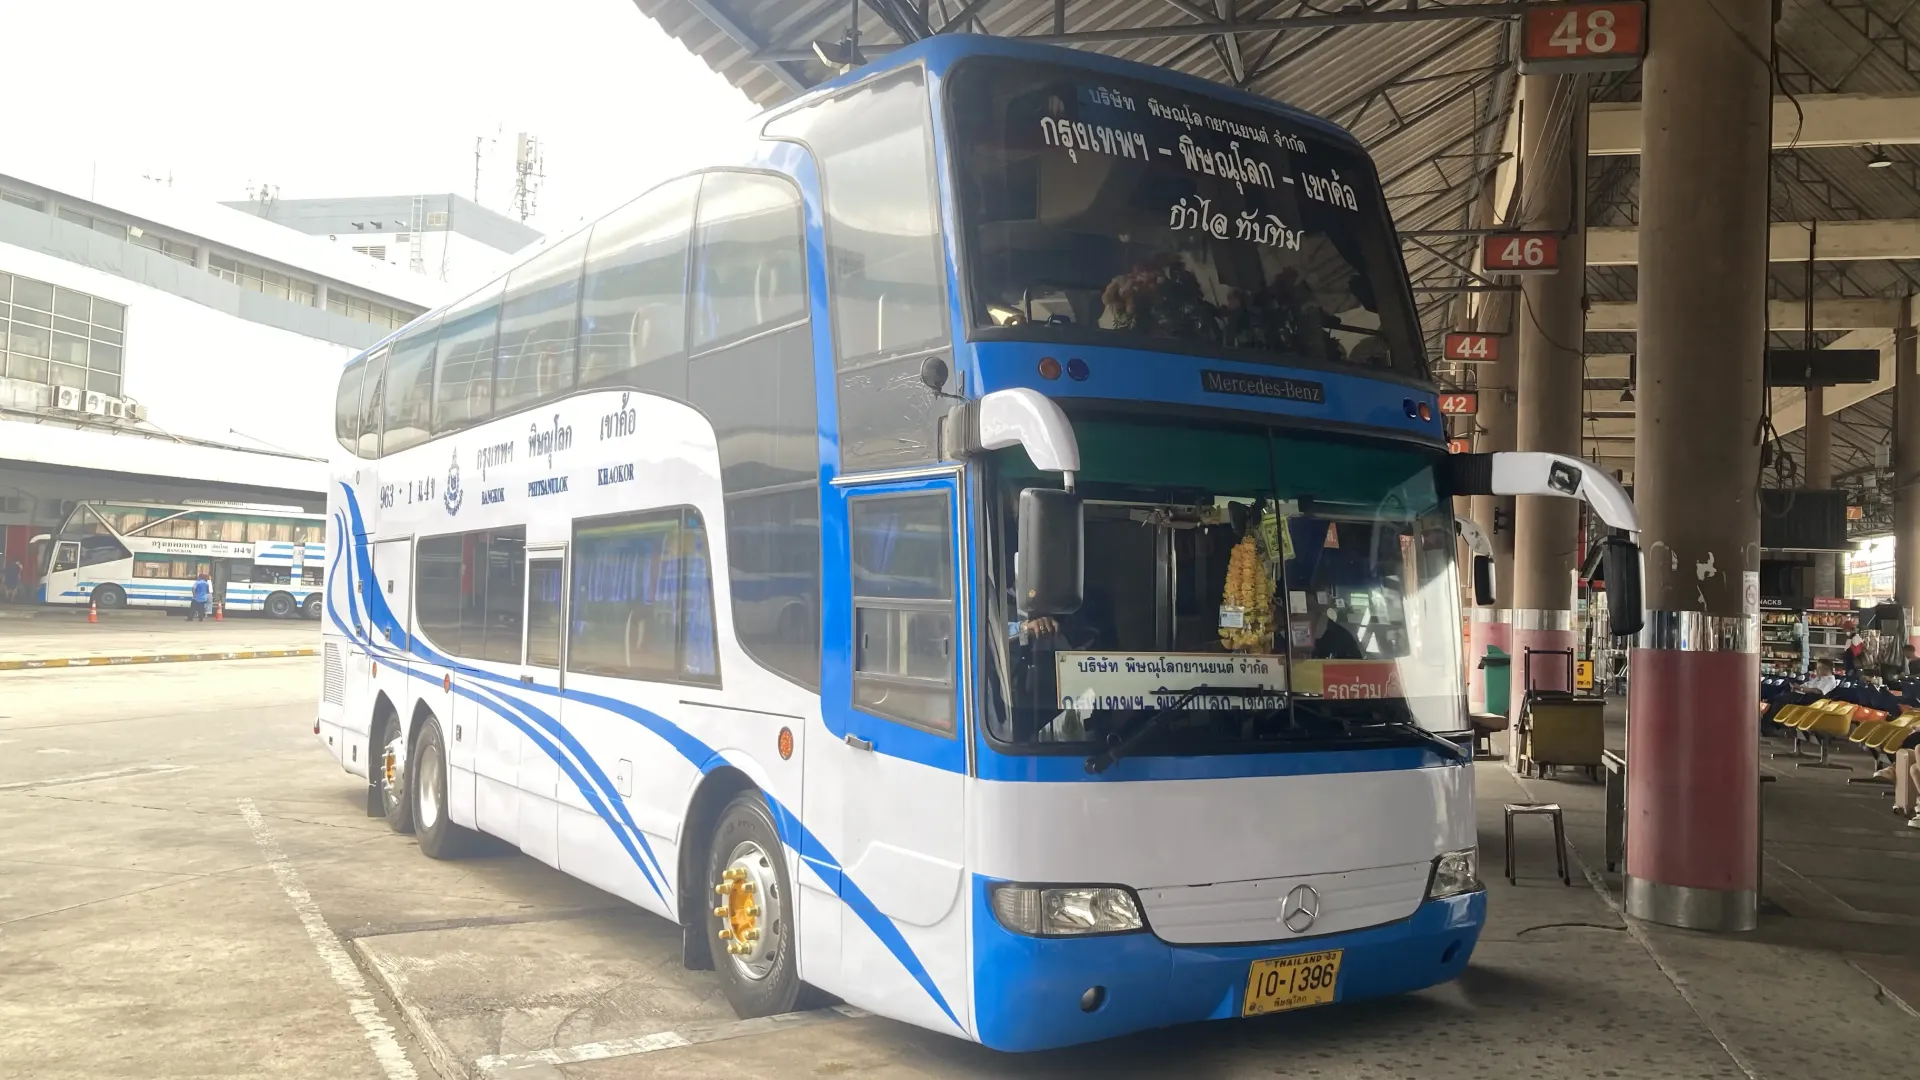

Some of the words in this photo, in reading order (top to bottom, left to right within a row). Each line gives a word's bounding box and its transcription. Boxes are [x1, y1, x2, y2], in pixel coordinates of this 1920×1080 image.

[1548, 9, 1617, 54] 48
[1088, 86, 1136, 112] บริษัท
[1273, 129, 1308, 154] จำกัด
[1040, 115, 1149, 164] กรุงเทพฯ
[1178, 134, 1275, 195] พิษณุโลก
[1301, 168, 1359, 212] เขาค้อ
[1169, 194, 1229, 240] กำไล
[1235, 208, 1305, 252] ทับทิม
[1501, 238, 1544, 266] 46
[1456, 337, 1488, 358] 44
[1208, 372, 1321, 401] Mercedes-Benz
[1442, 396, 1467, 413] 42
[528, 413, 572, 470] พิษณุโลก
[599, 391, 636, 441] เขาค้อ
[380, 483, 394, 509] 963
[481, 487, 506, 505] BANGKOK
[528, 476, 568, 497] PHITSANULOK
[597, 463, 634, 486] KHAOKOR
[1078, 656, 1118, 673] บริษัท
[1125, 656, 1234, 678] พิษณุโลกยานยนต์
[1239, 658, 1268, 674] จำกัด
[1328, 676, 1382, 699] รถร่วม
[1274, 955, 1322, 968] THAILAND
[1256, 963, 1334, 998] 10-1396
